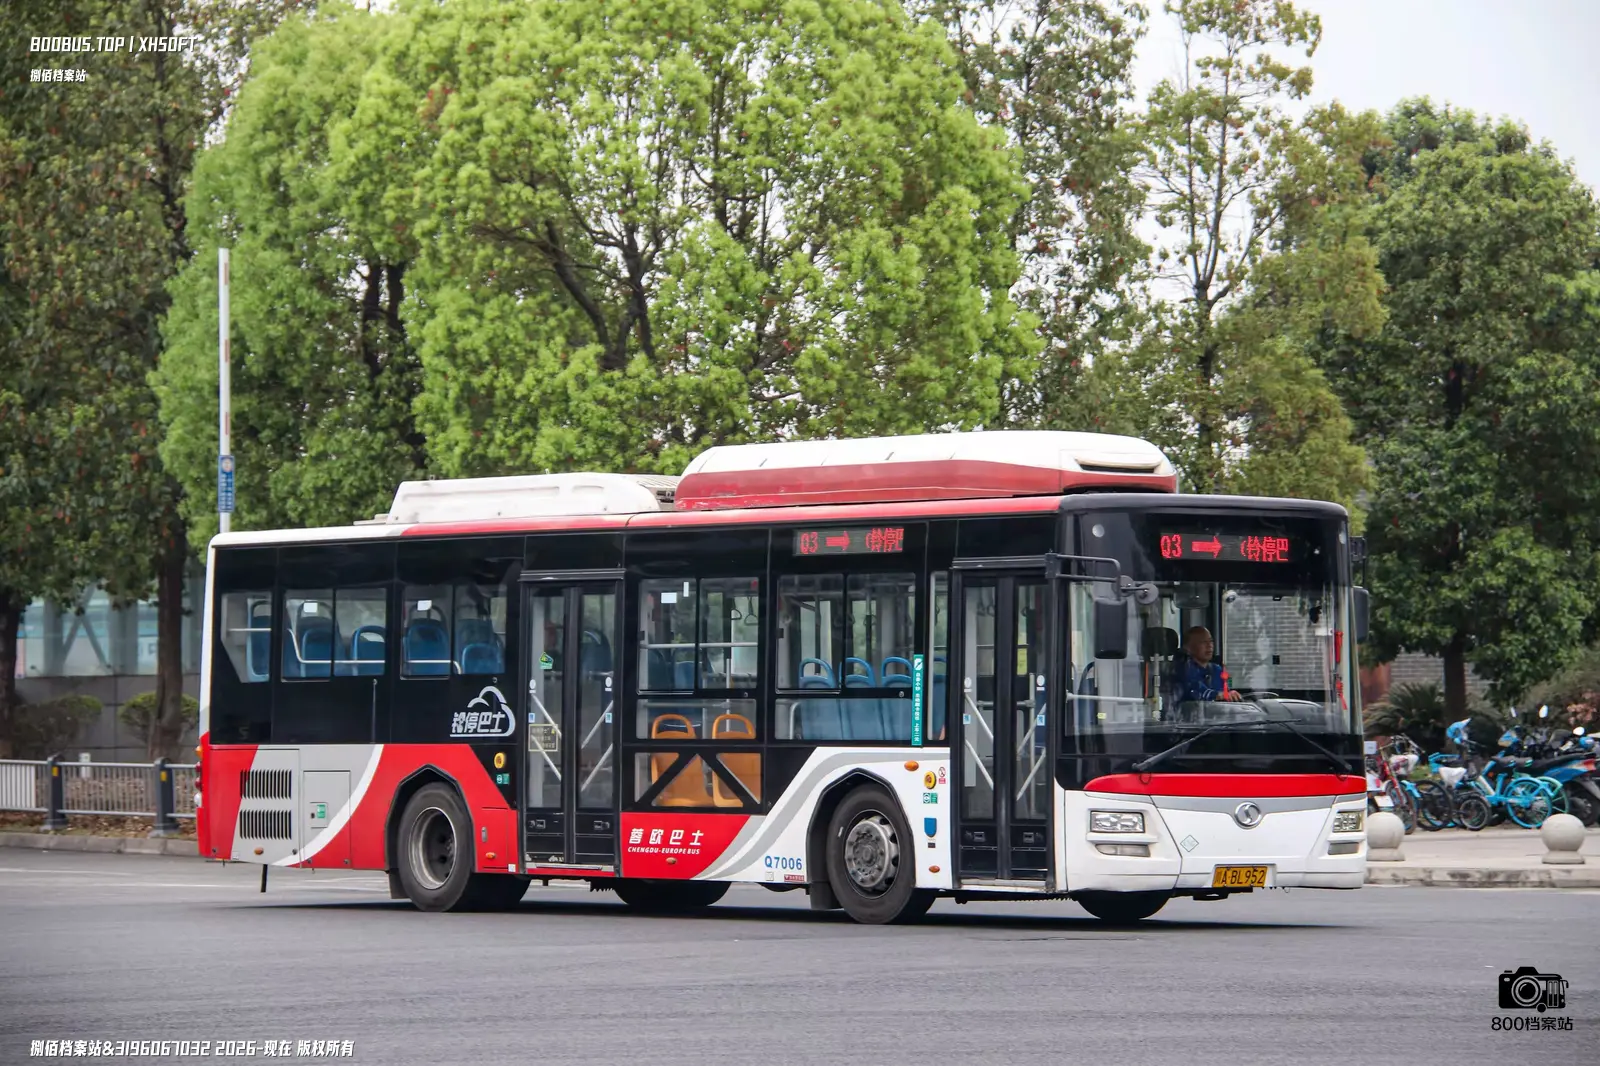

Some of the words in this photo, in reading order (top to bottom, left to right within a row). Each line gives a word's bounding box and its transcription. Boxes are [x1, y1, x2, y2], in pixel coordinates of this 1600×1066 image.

[1160, 534, 1183, 559] Q3
[451, 711, 506, 733] 铃停巴士
[628, 828, 704, 845] 蓉欧巴士
[628, 846, 686, 854] CHENGDU-EUROPE
[764, 855, 803, 871] Q7006
